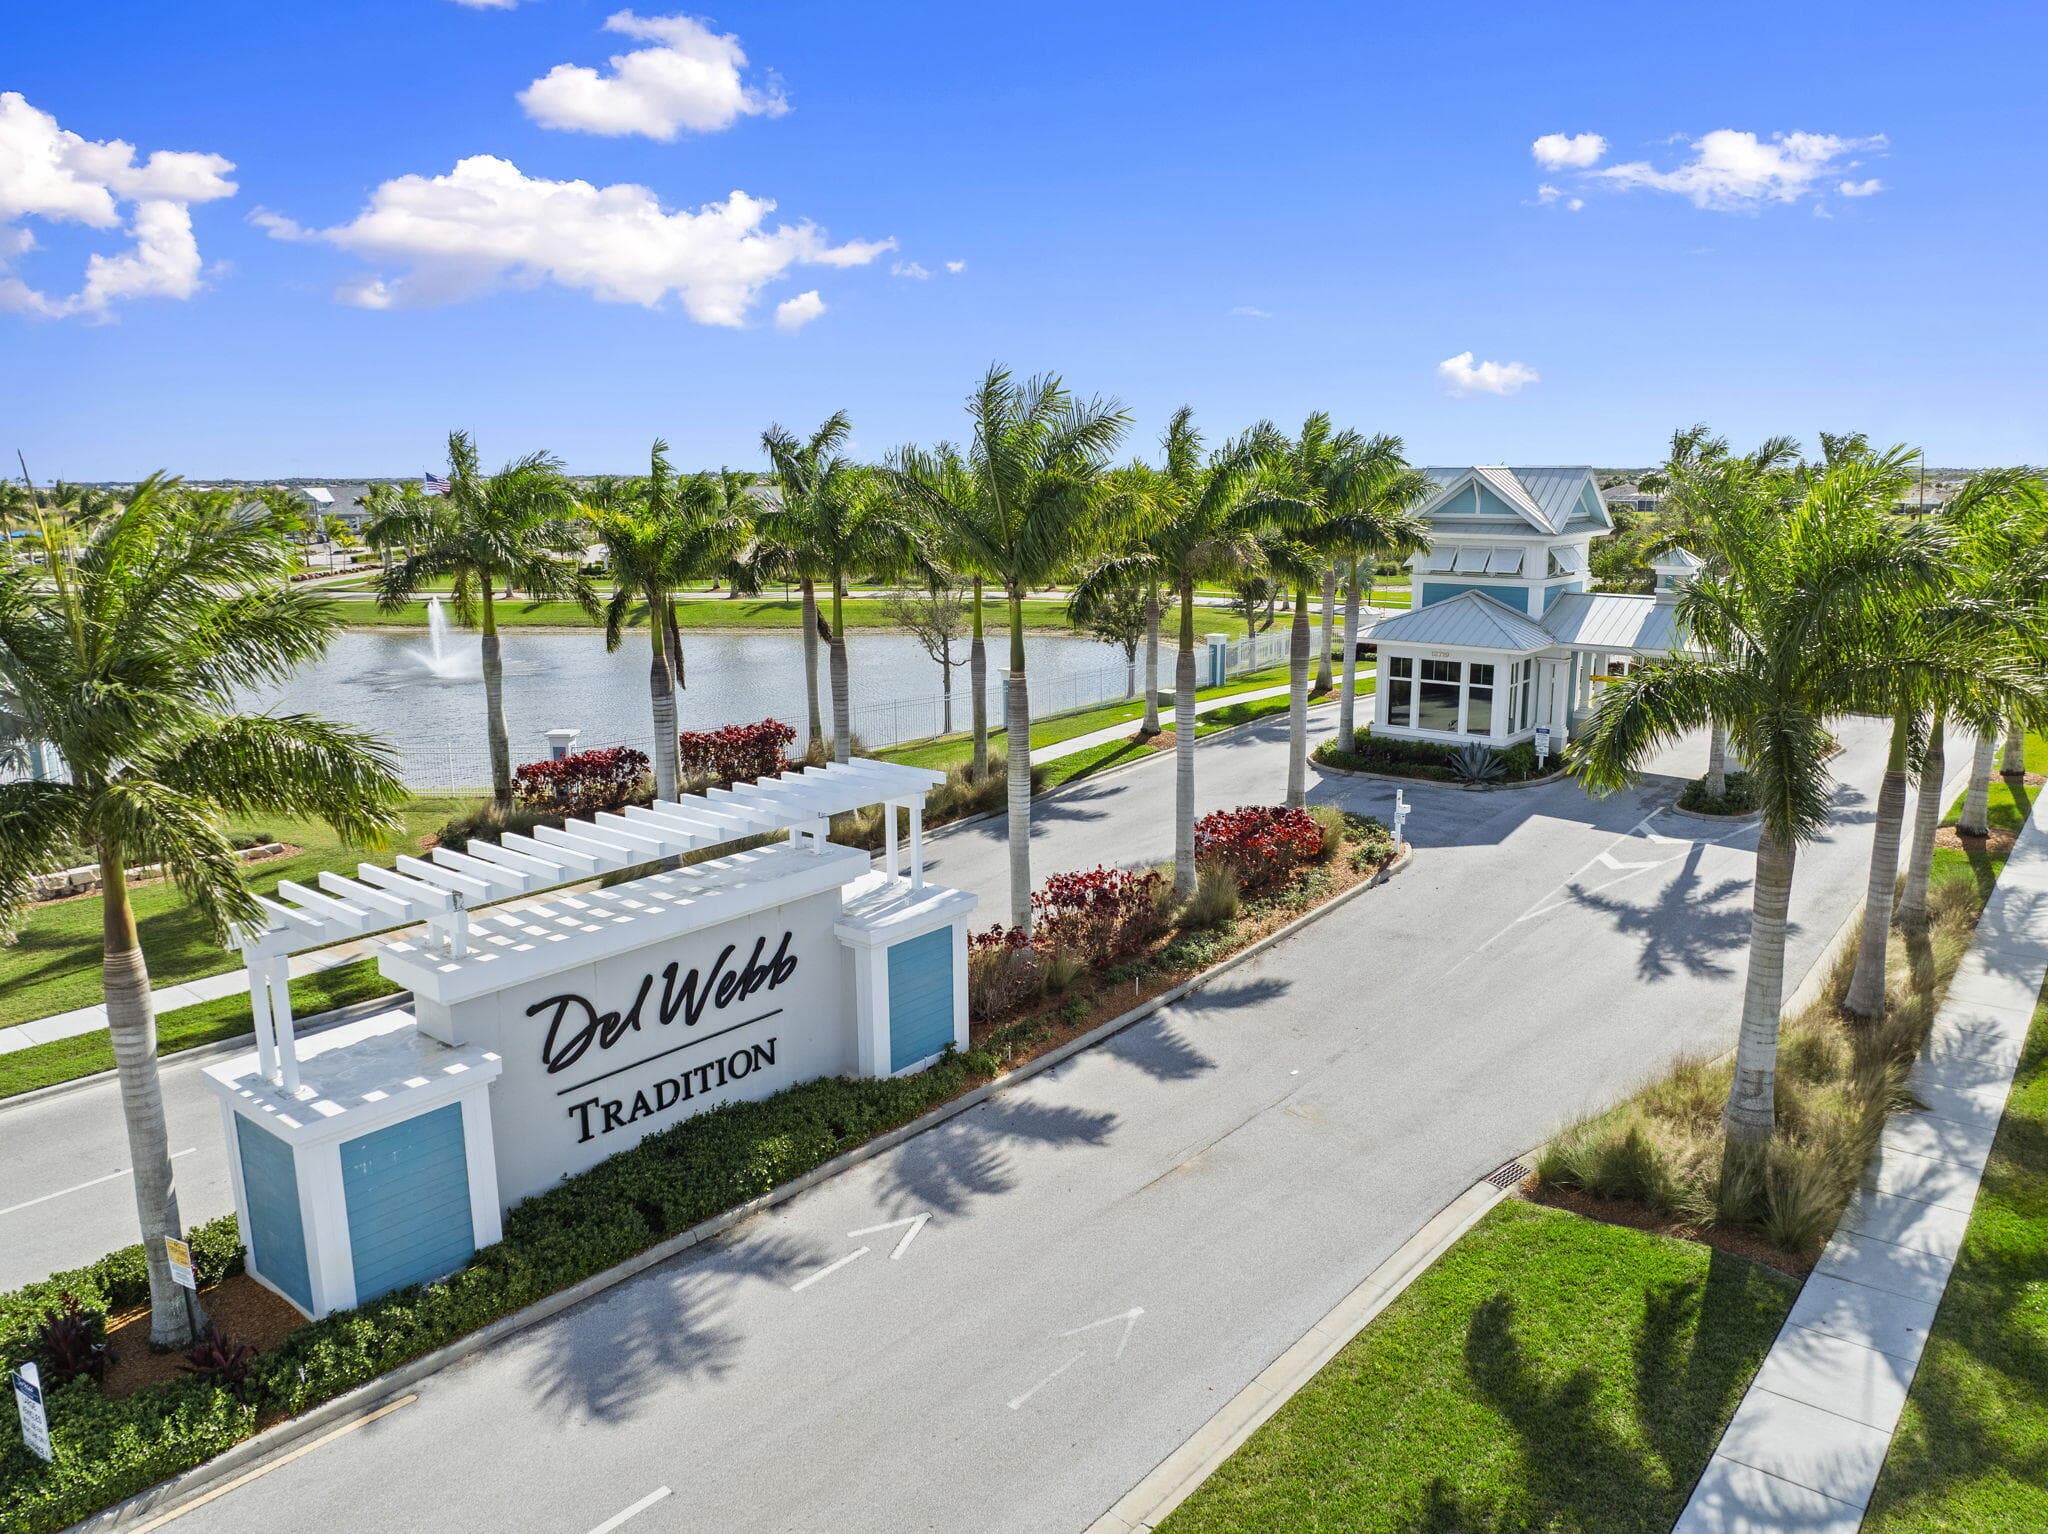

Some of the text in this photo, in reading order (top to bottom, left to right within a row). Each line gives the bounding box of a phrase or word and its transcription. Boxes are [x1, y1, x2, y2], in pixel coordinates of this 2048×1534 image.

[526, 931, 798, 1074] Del Webb
[568, 1037, 777, 1143] TRADITION
